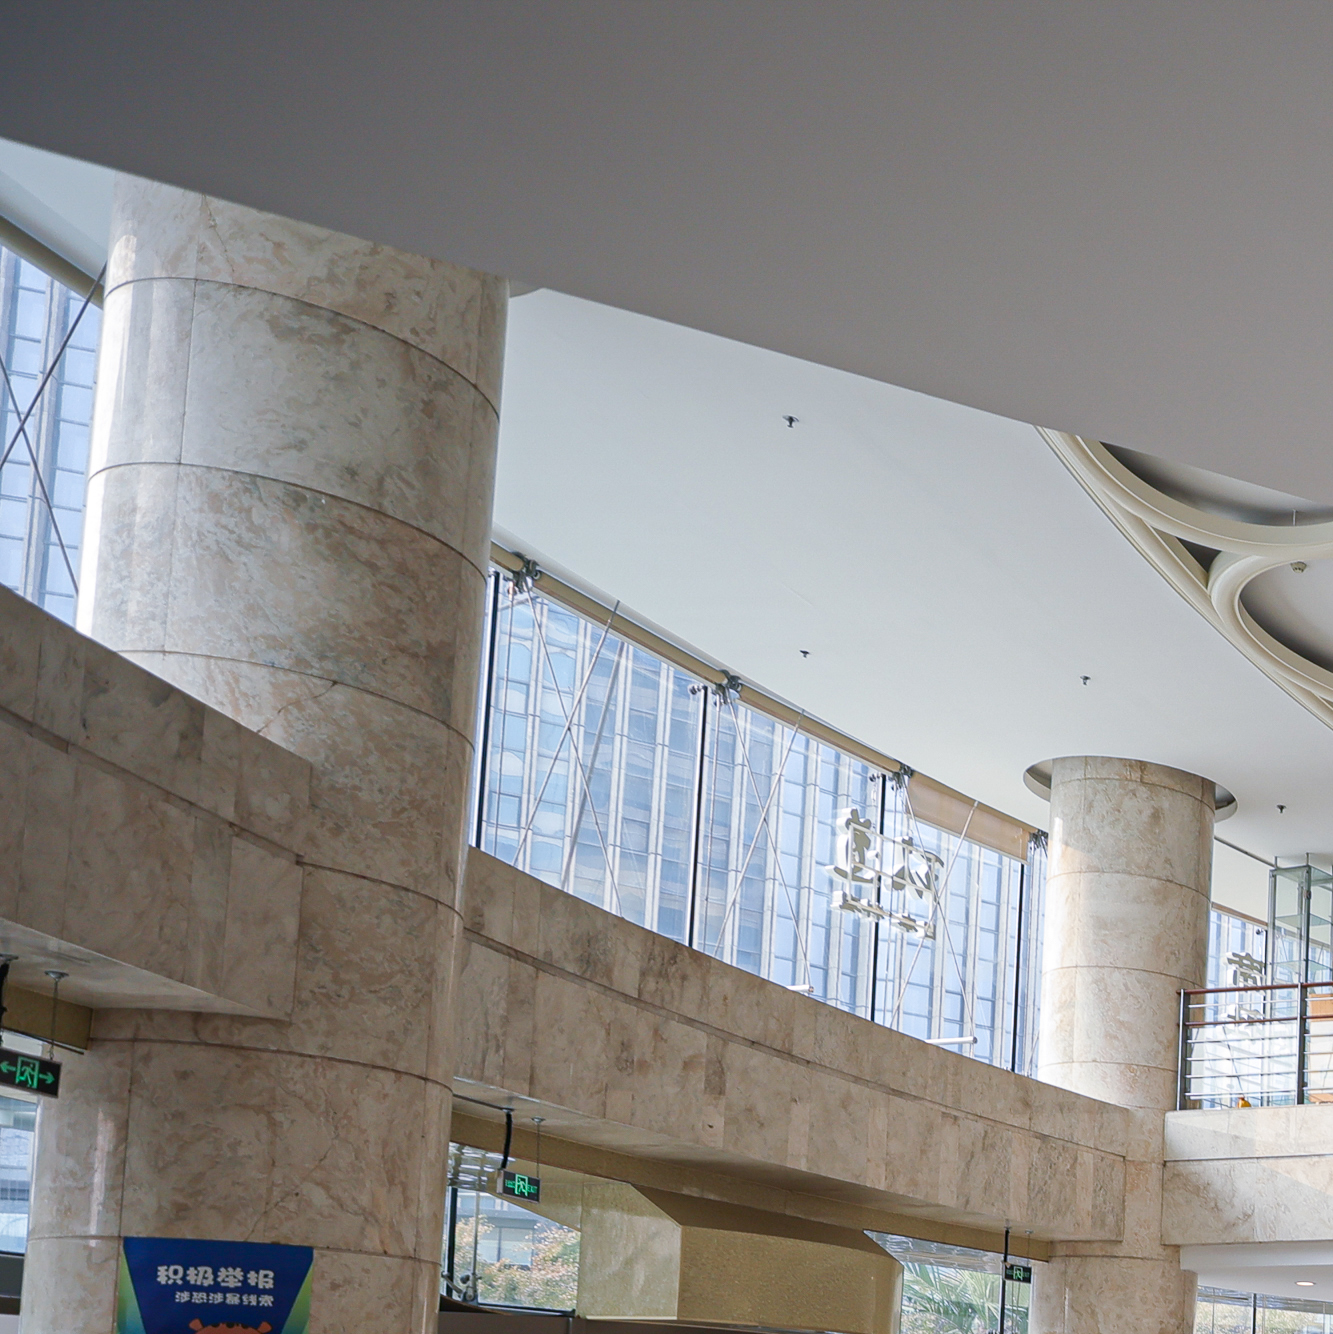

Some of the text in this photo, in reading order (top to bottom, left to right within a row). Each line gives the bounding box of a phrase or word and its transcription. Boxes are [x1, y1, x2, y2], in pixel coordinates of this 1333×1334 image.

[157, 1264, 275, 1290] 积极举报
[175, 1291, 275, 1308] 涉恐涉暴线索
